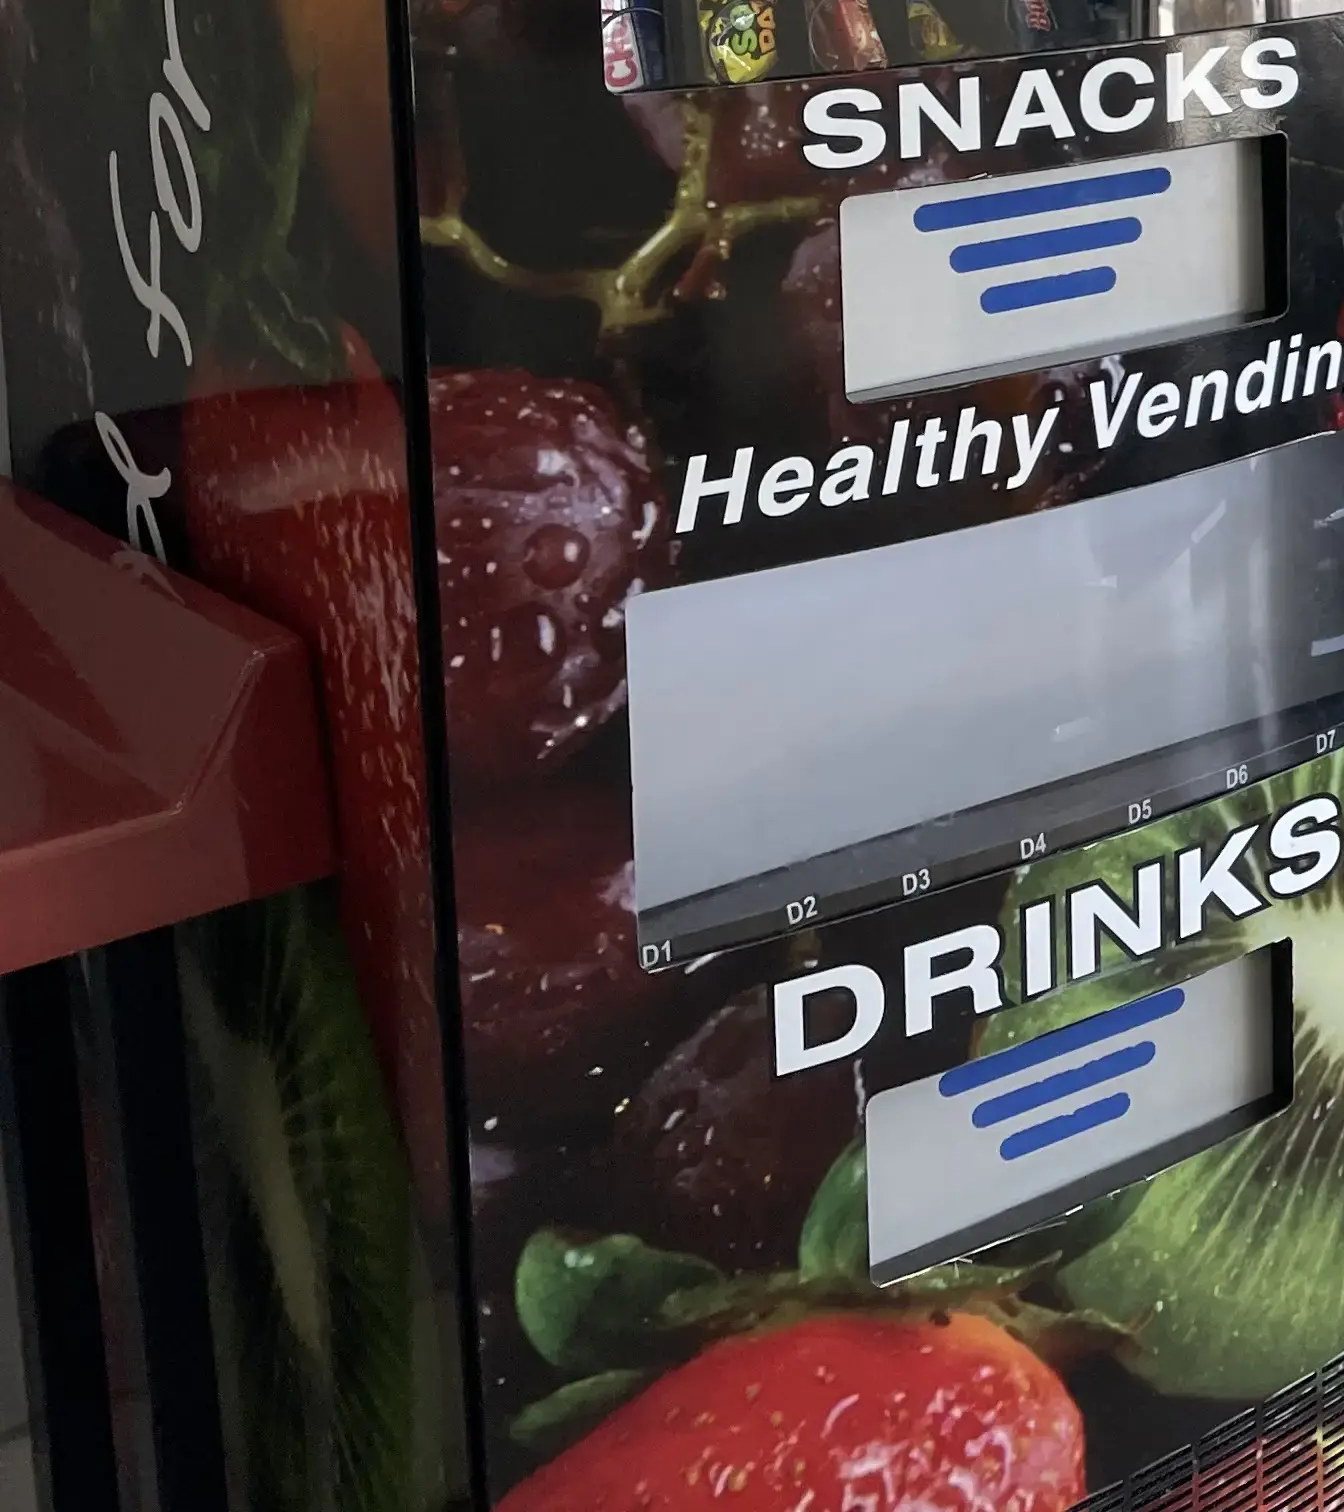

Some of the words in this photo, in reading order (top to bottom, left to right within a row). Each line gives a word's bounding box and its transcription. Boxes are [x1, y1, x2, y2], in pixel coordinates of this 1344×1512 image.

[802, 37, 1300, 170] SNACKS
[675, 404, 1060, 534] Healthy
[642, 940, 672, 968] D1
[787, 895, 818, 925] D2
[902, 868, 931, 896] D3
[1020, 834, 1047, 860] D4
[1126, 798, 1150, 825] D5
[1224, 764, 1246, 789] D6
[1314, 729, 1335, 754] D7
[773, 794, 1343, 1078] DRINKS
